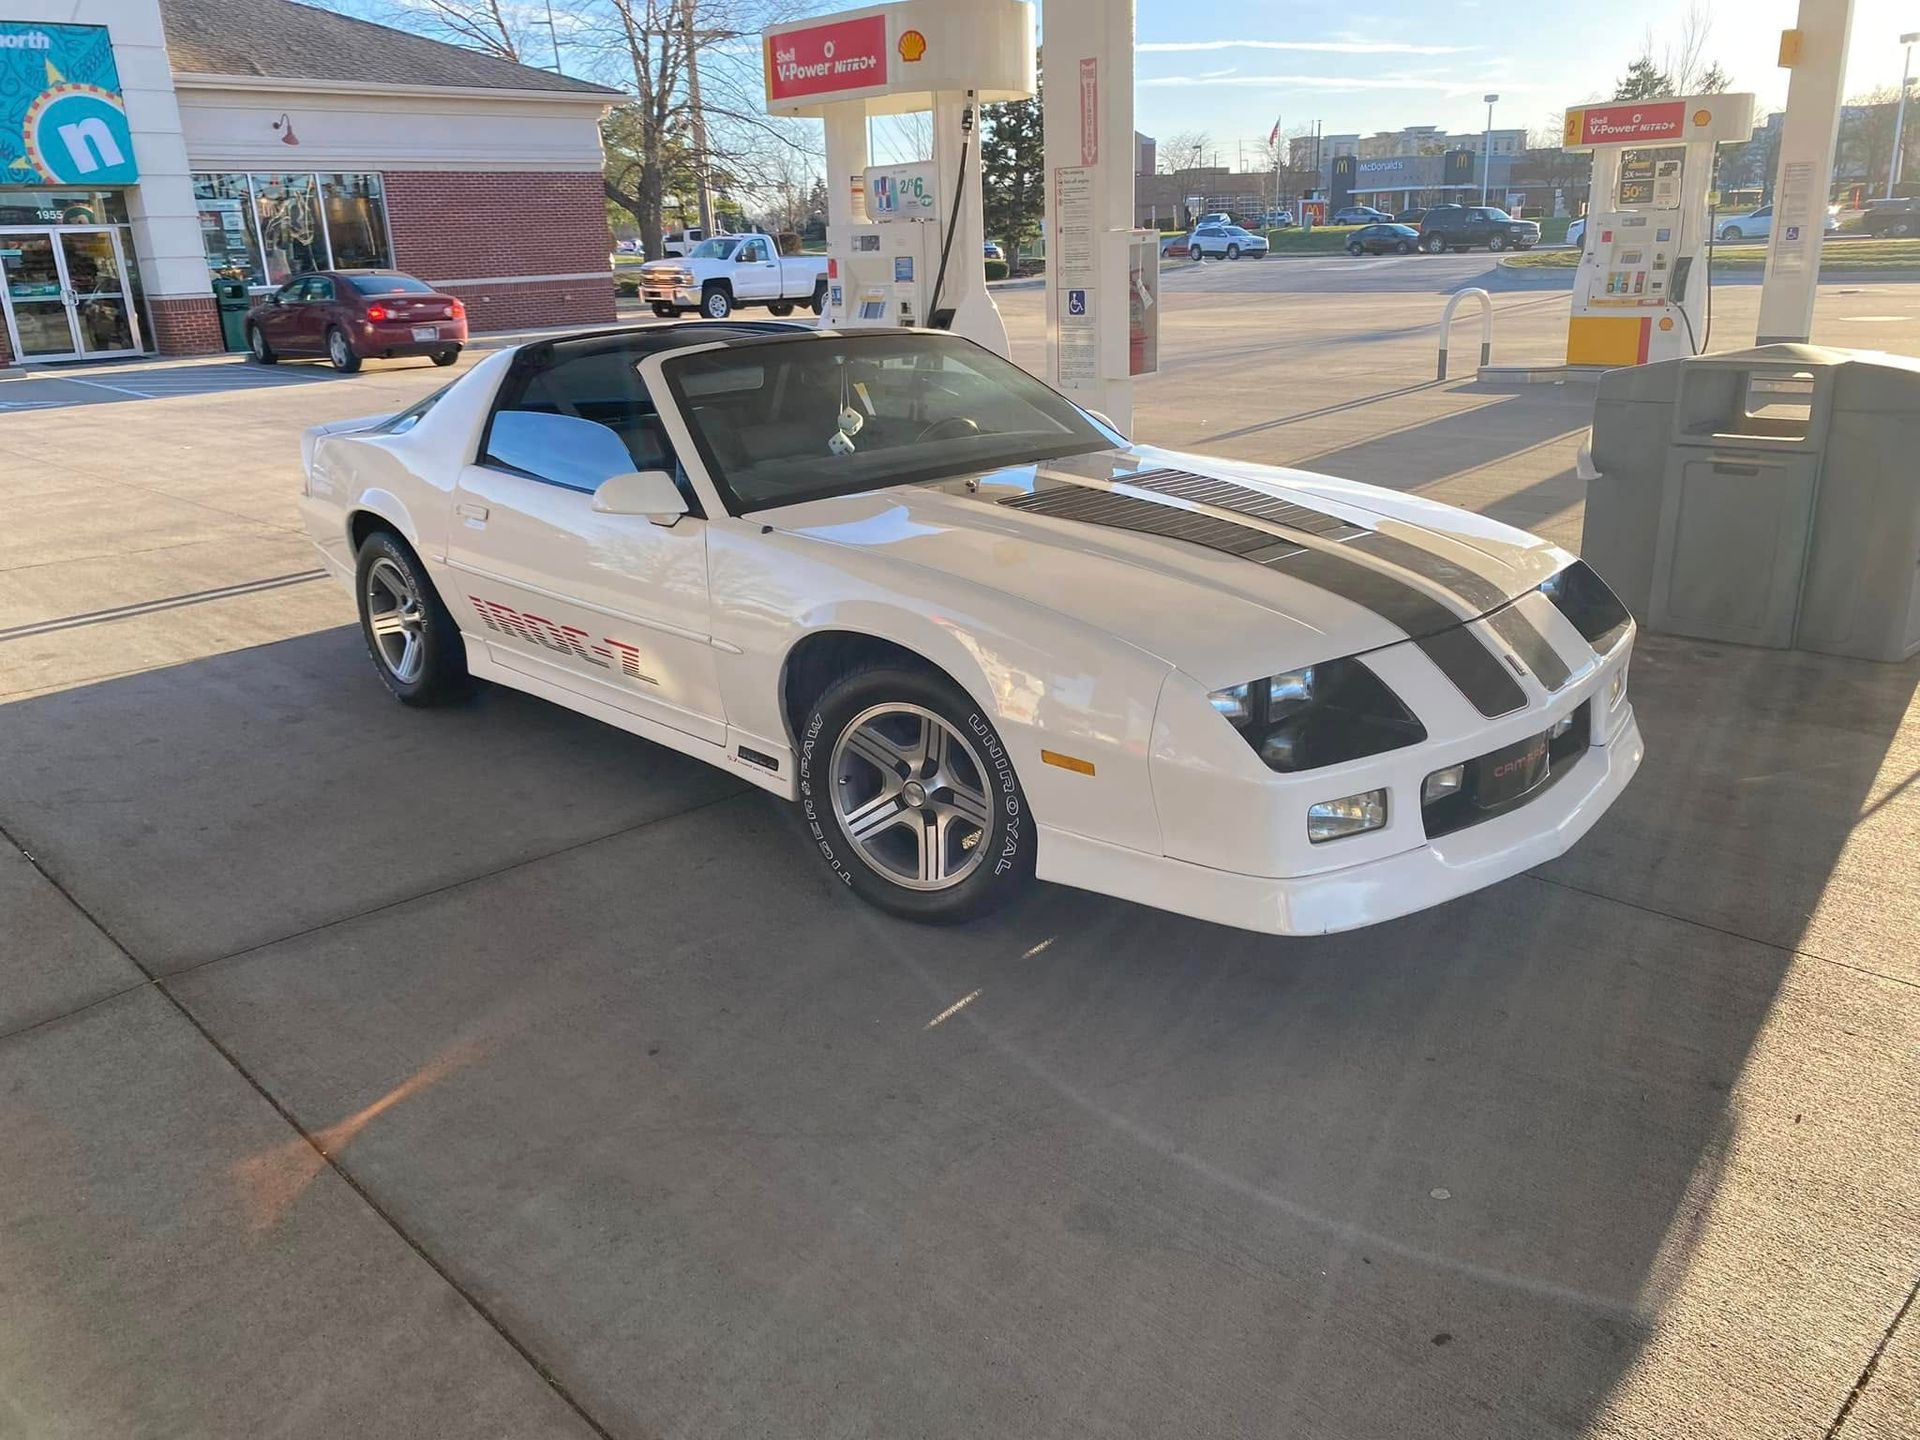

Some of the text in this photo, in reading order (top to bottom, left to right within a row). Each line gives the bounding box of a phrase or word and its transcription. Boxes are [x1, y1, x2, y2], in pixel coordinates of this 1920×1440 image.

[776, 48, 796, 63] Shell
[777, 62, 831, 81] V-Power
[1590, 117, 1608, 125] Shell
[1590, 124, 1636, 135] V-Power
[57, 117, 125, 174] n
[1360, 160, 1403, 172] McDonald's
[36, 210, 63, 220] 1955
[801, 713, 852, 886] TIGER PAW
[969, 713, 1019, 876] UNIROYAL
